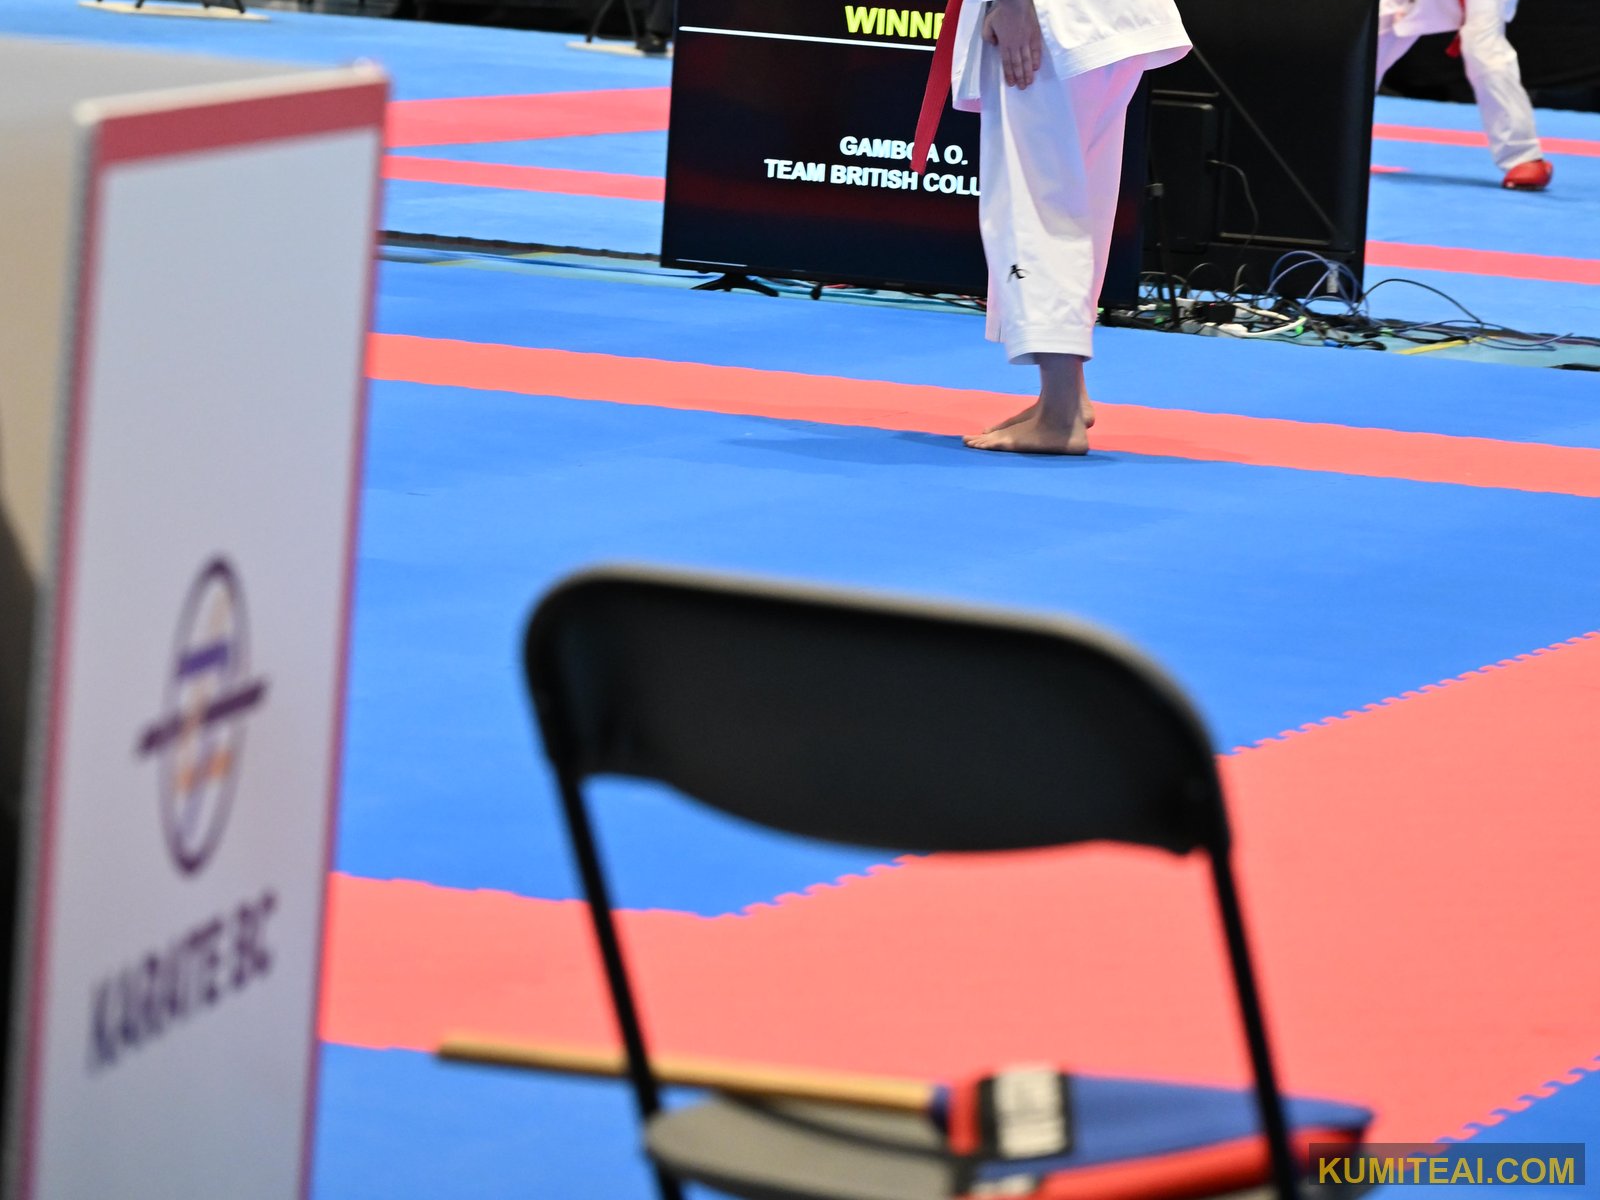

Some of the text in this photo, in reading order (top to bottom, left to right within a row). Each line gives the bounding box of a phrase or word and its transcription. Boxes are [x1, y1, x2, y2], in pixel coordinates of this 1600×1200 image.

[944, 145, 968, 165] O.
[764, 158, 826, 182] TEAM
[830, 164, 918, 190] BRITISH
